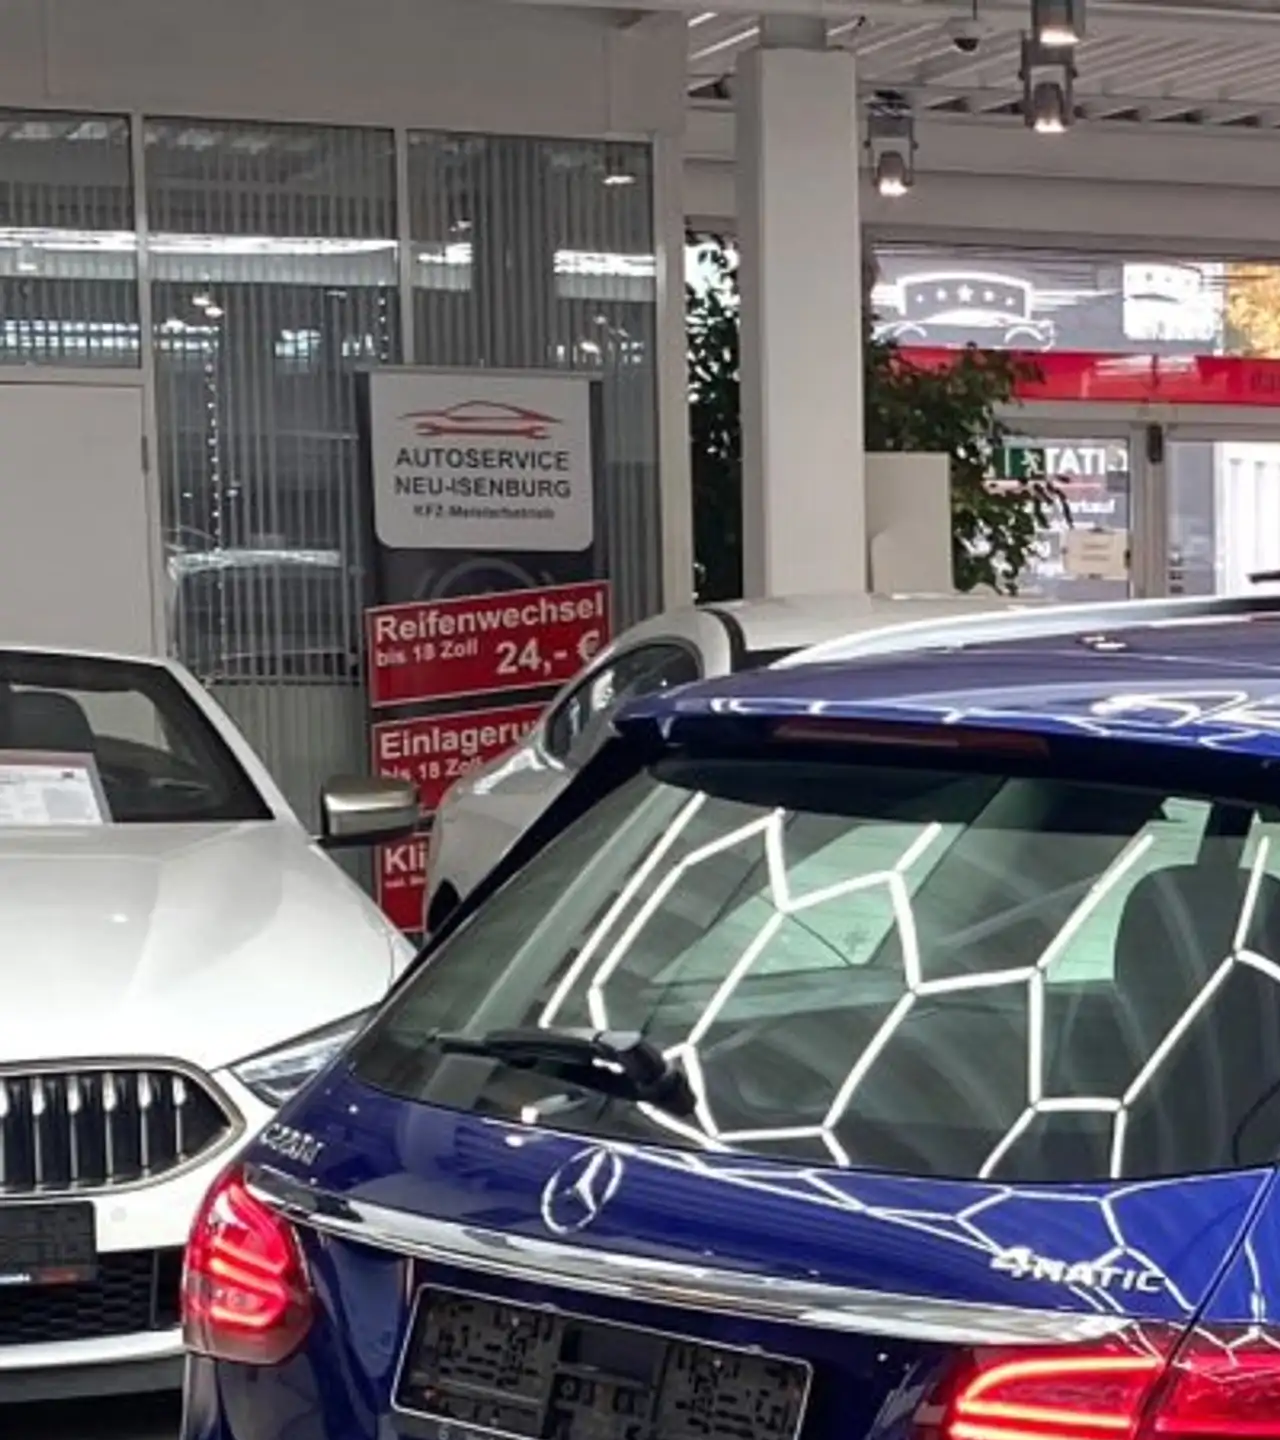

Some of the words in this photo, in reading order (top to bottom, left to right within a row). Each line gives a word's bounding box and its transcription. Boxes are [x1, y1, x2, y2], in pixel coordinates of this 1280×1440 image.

[395, 447, 570, 471] AUTOSERVICE
[394, 476, 571, 499] NEU-ISENBURG
[376, 591, 604, 642] Reifenwechsel
[376, 647, 407, 667] bis
[413, 643, 435, 662] 18
[439, 638, 478, 658] Zoll
[380, 720, 536, 758] Einlageru
[419, 761, 441, 779] 18
[989, 1246, 1163, 1292] 4MATIC
